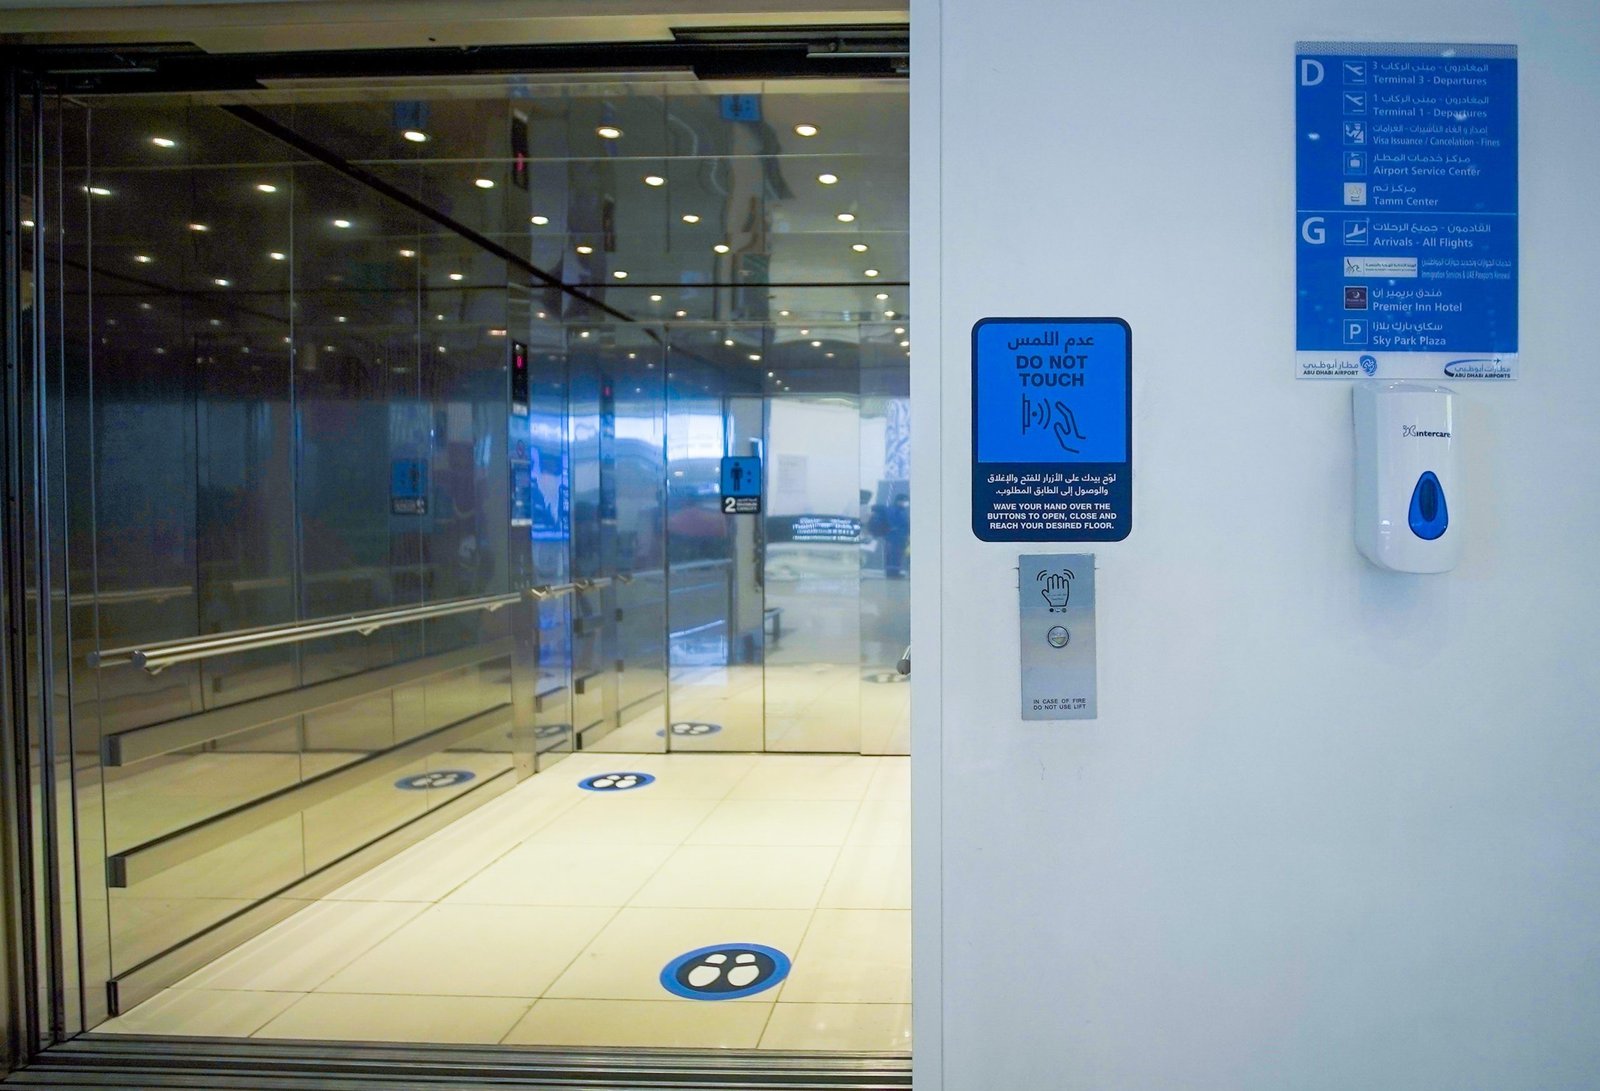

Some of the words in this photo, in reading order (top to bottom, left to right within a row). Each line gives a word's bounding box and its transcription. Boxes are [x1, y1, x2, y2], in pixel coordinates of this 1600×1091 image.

[1372, 62, 1377, 70] 3
[1381, 63, 1410, 71] الركاب
[1412, 63, 1436, 72] مبنى
[1445, 64, 1488, 72] المغادرون
[1301, 59, 1325, 86] D
[1374, 75, 1415, 84] Terminal
[1419, 76, 1424, 84] 3
[1433, 77, 1487, 86] Departures
[1382, 95, 1410, 103] الركاب
[1413, 95, 1436, 104] مبنى
[1445, 96, 1489, 104] المغادرون
[1374, 108, 1415, 116] Terminal
[1420, 108, 1424, 116] 1
[1434, 109, 1487, 118] Departures
[1373, 136, 1389, 144] Visa
[1391, 137, 1423, 145] Issuance
[1424, 137, 1428, 145] /
[1430, 137, 1474, 146] Cancelation
[1374, 154, 1405, 162] المطار
[1408, 154, 1443, 162] خدمات
[1446, 154, 1470, 163] مركز
[1374, 167, 1408, 176] Airport
[1412, 167, 1446, 175] Service
[1449, 168, 1480, 176] Center
[1373, 185, 1388, 193] تم
[1392, 184, 1416, 193] مركز
[1373, 196, 1403, 205] Tamm
[1407, 197, 1438, 206] Center
[1302, 217, 1325, 244] G
[1373, 223, 1408, 232] الرحلات
[1411, 223, 1438, 233] جميع
[1448, 224, 1491, 233] القادمون
[1374, 237, 1412, 246] Arrivals
[1423, 238, 1436, 247] All
[1440, 238, 1473, 249] Flights
[1373, 288, 1383, 298] إن
[1386, 289, 1413, 299] بريمير
[1416, 288, 1442, 298] فندق
[1373, 302, 1412, 311] Premier
[1416, 303, 1431, 311] Inn
[1435, 302, 1462, 312] Hotel
[1350, 324, 1361, 339] P
[1373, 322, 1389, 332] بلازا
[1392, 322, 1412, 332] بارك
[1414, 322, 1442, 334] سكاي
[1008, 331, 1059, 350] اللمس
[1065, 335, 1094, 352] عدم
[1373, 336, 1391, 347] Sky
[1395, 336, 1416, 345] Park
[1420, 336, 1446, 345] Plaza
[1016, 356, 1042, 369] DO
[1050, 356, 1088, 369] NOT
[1019, 373, 1084, 387] TOUCH
[1416, 430, 1451, 438] intercare
[987, 473, 1018, 484] والإغلاق
[1021, 474, 1040, 484] للفتح
[1043, 473, 1062, 483] الأزرار
[1065, 474, 1079, 483] على
[1081, 474, 1101, 484] بيدك
[996, 486, 1031, 496] المطلوب.
[1034, 486, 1058, 496] الطابق
[1061, 487, 1073, 496] إلى
[1075, 486, 1108, 496] والوصول
[725, 497, 736, 512] 2
[1042, 513, 1067, 521] OPEN,
